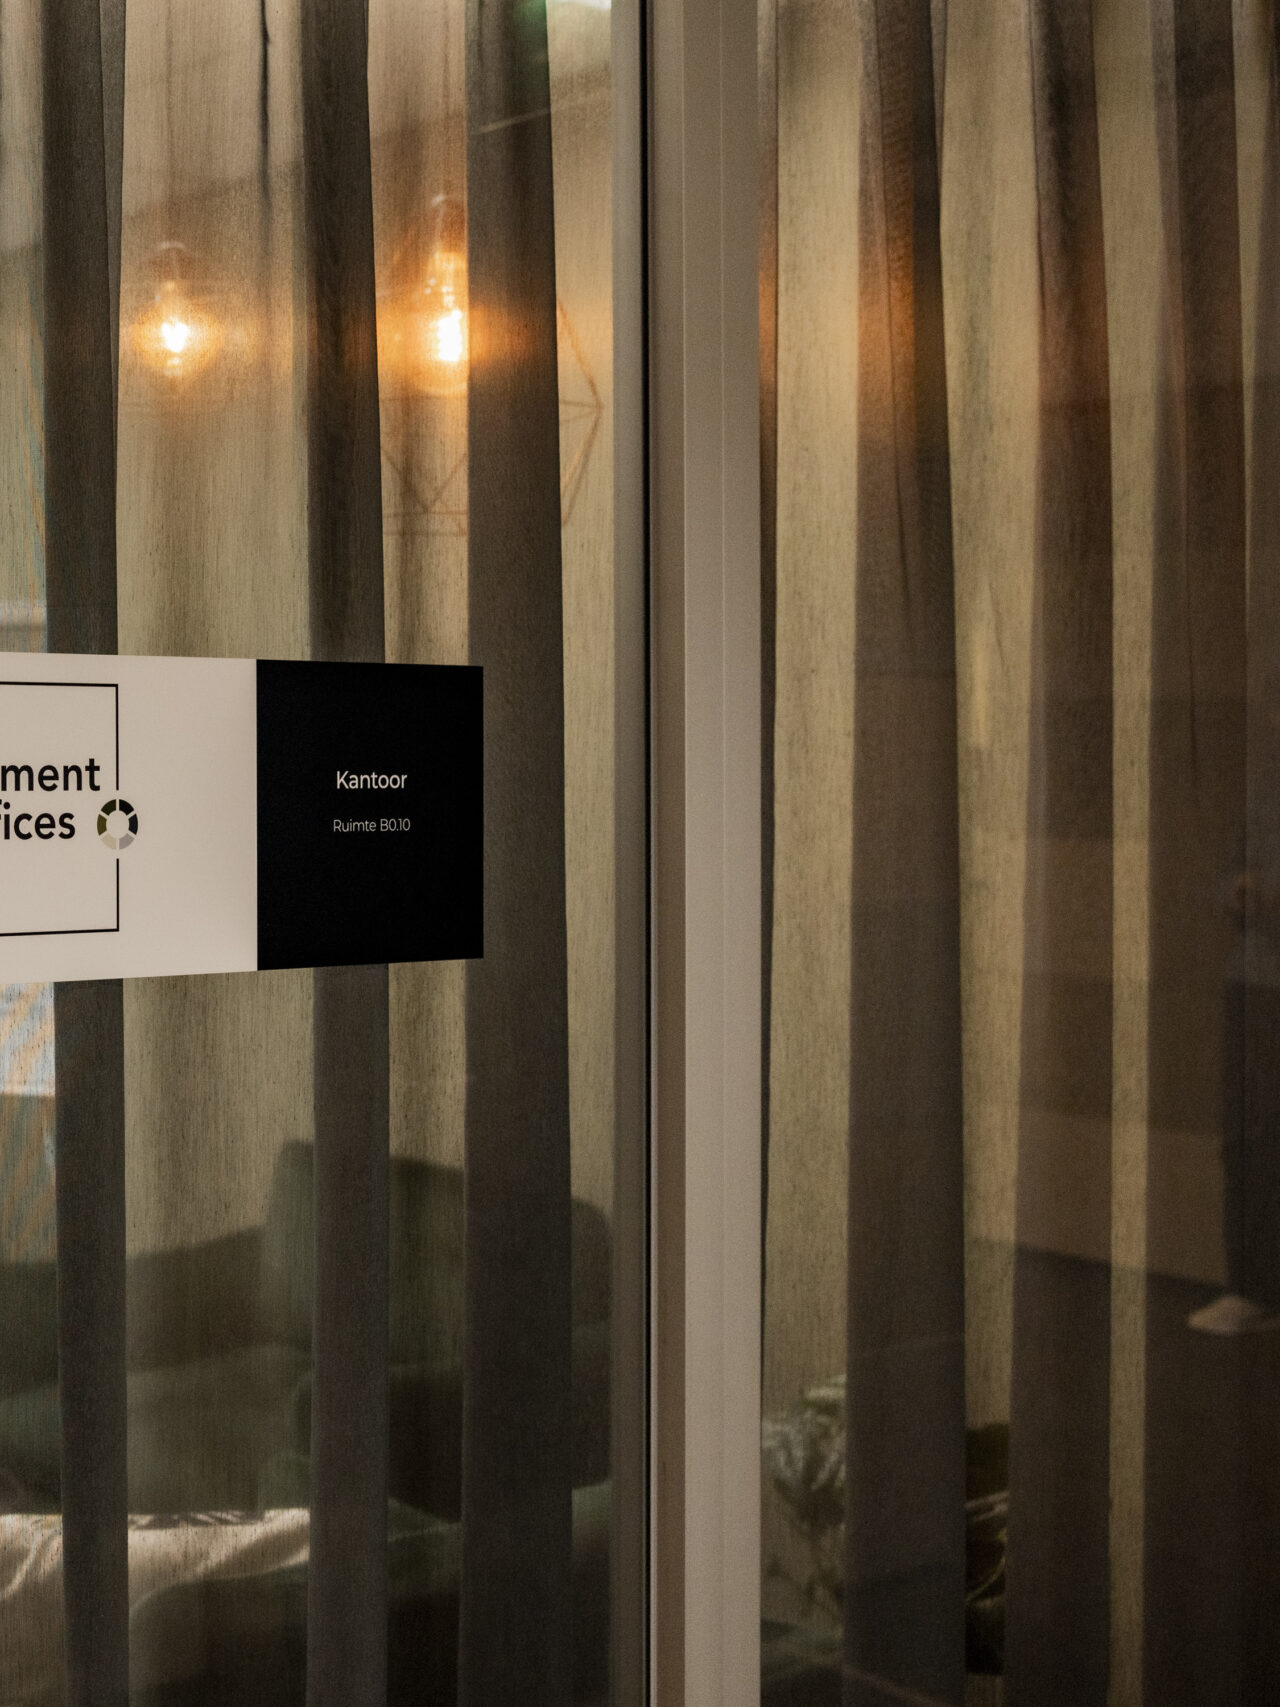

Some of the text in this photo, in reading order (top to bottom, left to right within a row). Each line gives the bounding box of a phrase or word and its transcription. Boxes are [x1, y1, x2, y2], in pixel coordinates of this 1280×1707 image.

[336, 770, 408, 789] Kantoor
[333, 818, 411, 832] Ruimte B0.10
